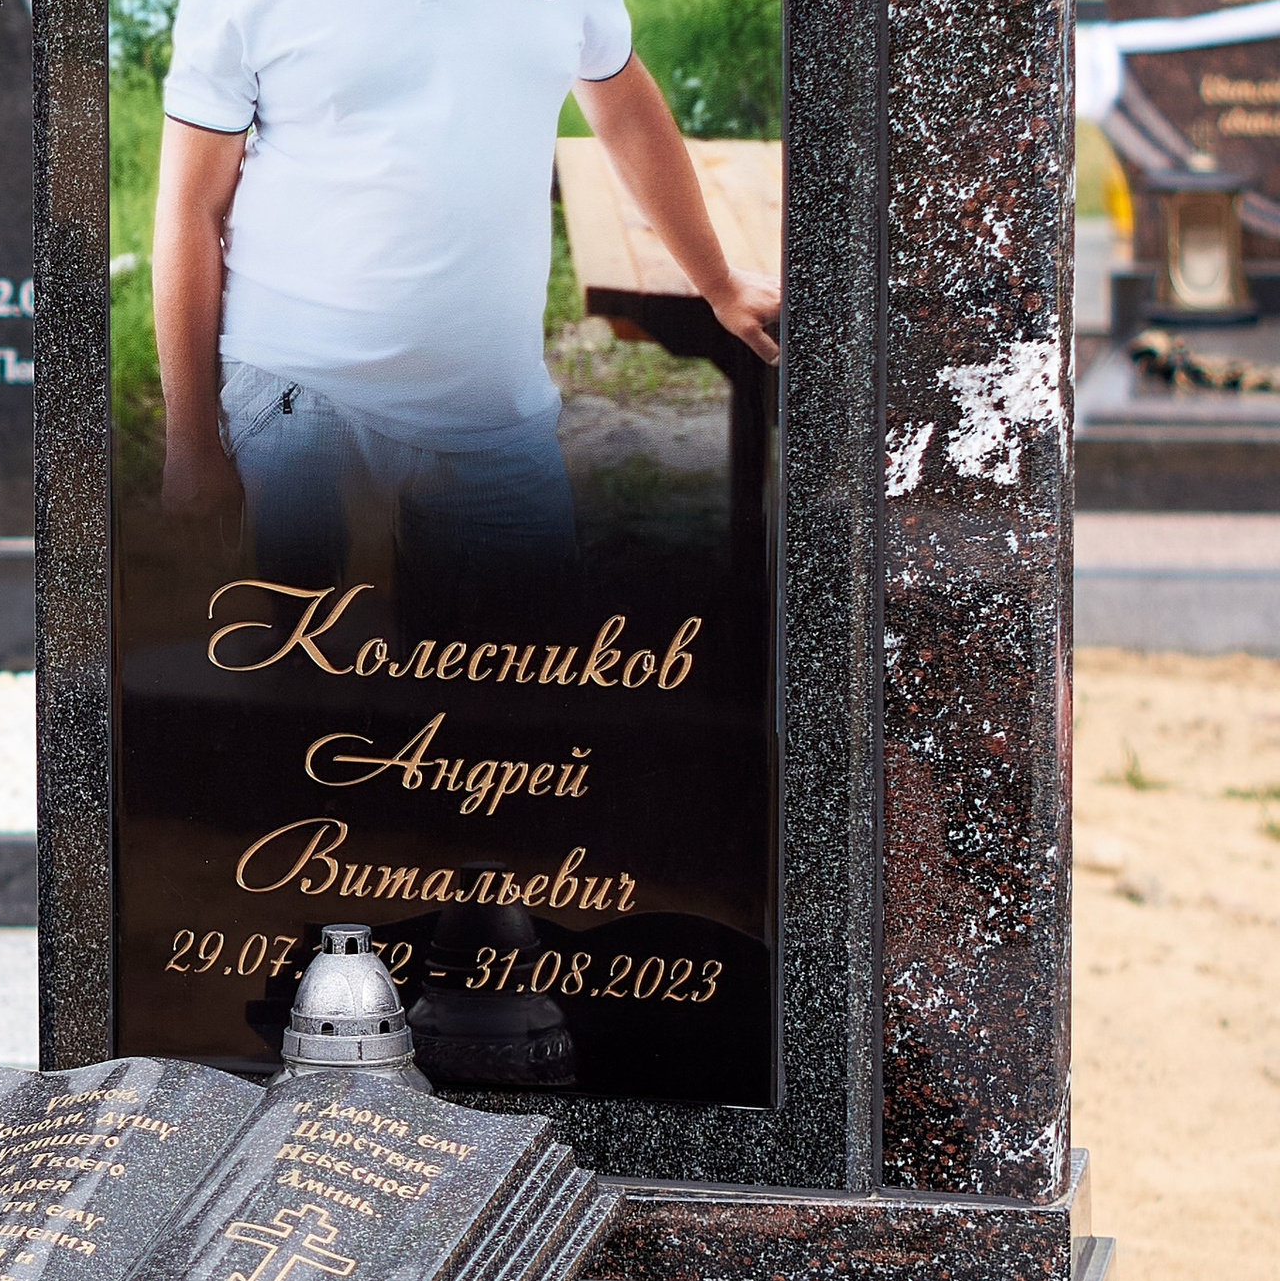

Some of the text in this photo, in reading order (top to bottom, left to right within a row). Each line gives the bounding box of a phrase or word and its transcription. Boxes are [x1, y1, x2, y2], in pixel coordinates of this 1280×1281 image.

[206, 579, 703, 690] Колесников
[304, 711, 590, 815] Андрей
[235, 818, 637, 912] Витальевич
[163, 929, 413, 986] 29.07.2
[465, 946, 724, 1005] 31.08.2023
[46, 1088, 139, 1113] Упокой,
[96, 1111, 179, 1141] душу
[292, 1102, 478, 1161] и даруй ему
[292, 1120, 441, 1177] Царствие
[29, 1153, 126, 1176] Твоего
[276, 1144, 431, 1200] Небесное!
[46, 1204, 105, 1231] ему
[277, 1169, 383, 1219] Аминь.
[15, 1251, 34, 1265] и
